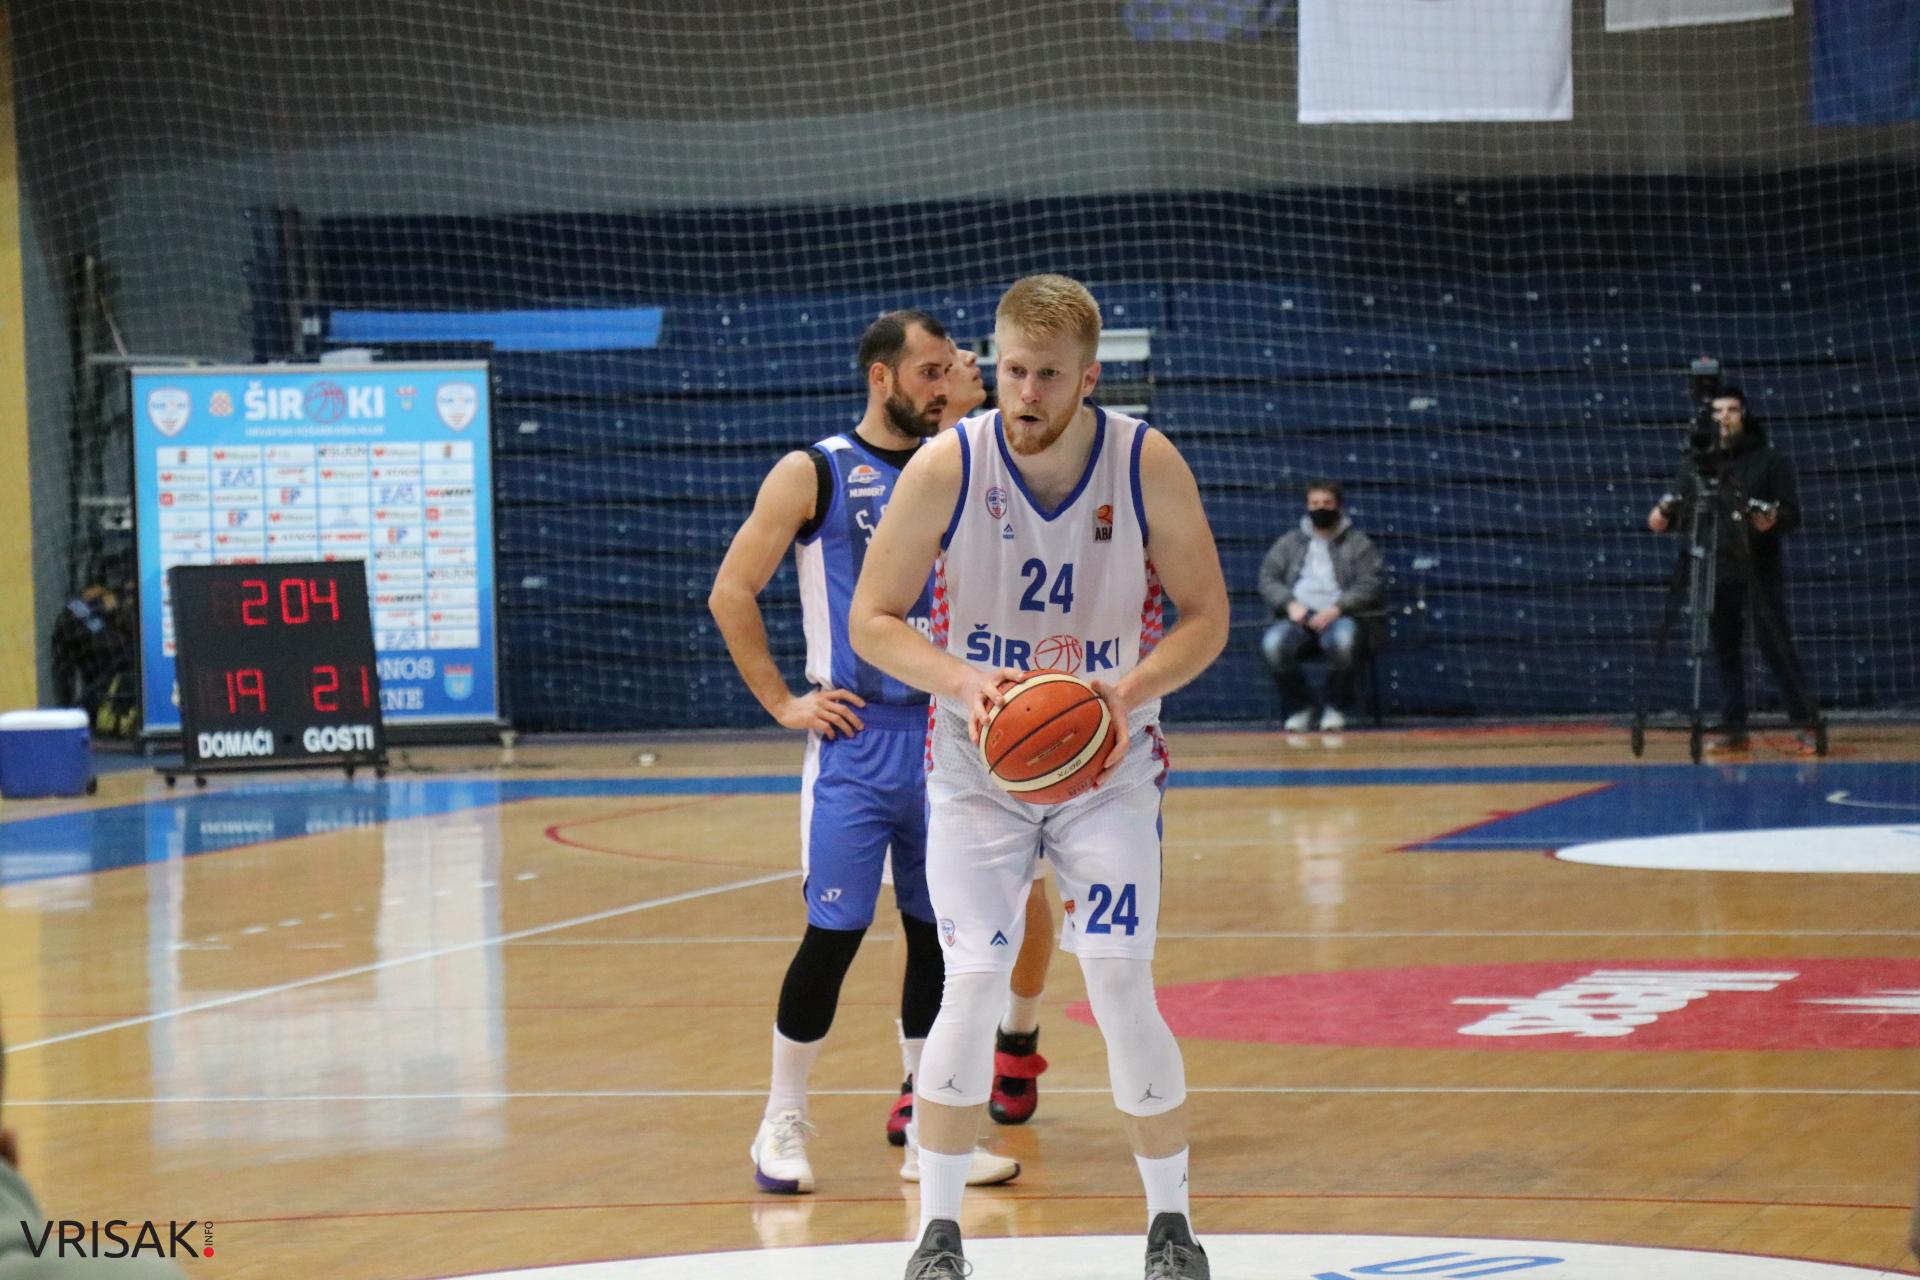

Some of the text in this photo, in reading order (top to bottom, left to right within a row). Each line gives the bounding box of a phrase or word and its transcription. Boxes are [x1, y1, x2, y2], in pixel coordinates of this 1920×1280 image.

[1019, 558, 1074, 614] 24
[226, 665, 371, 714] 19 21
[198, 725, 375, 758] DOMAĆI GOSTI
[1085, 883, 1138, 936] 24
